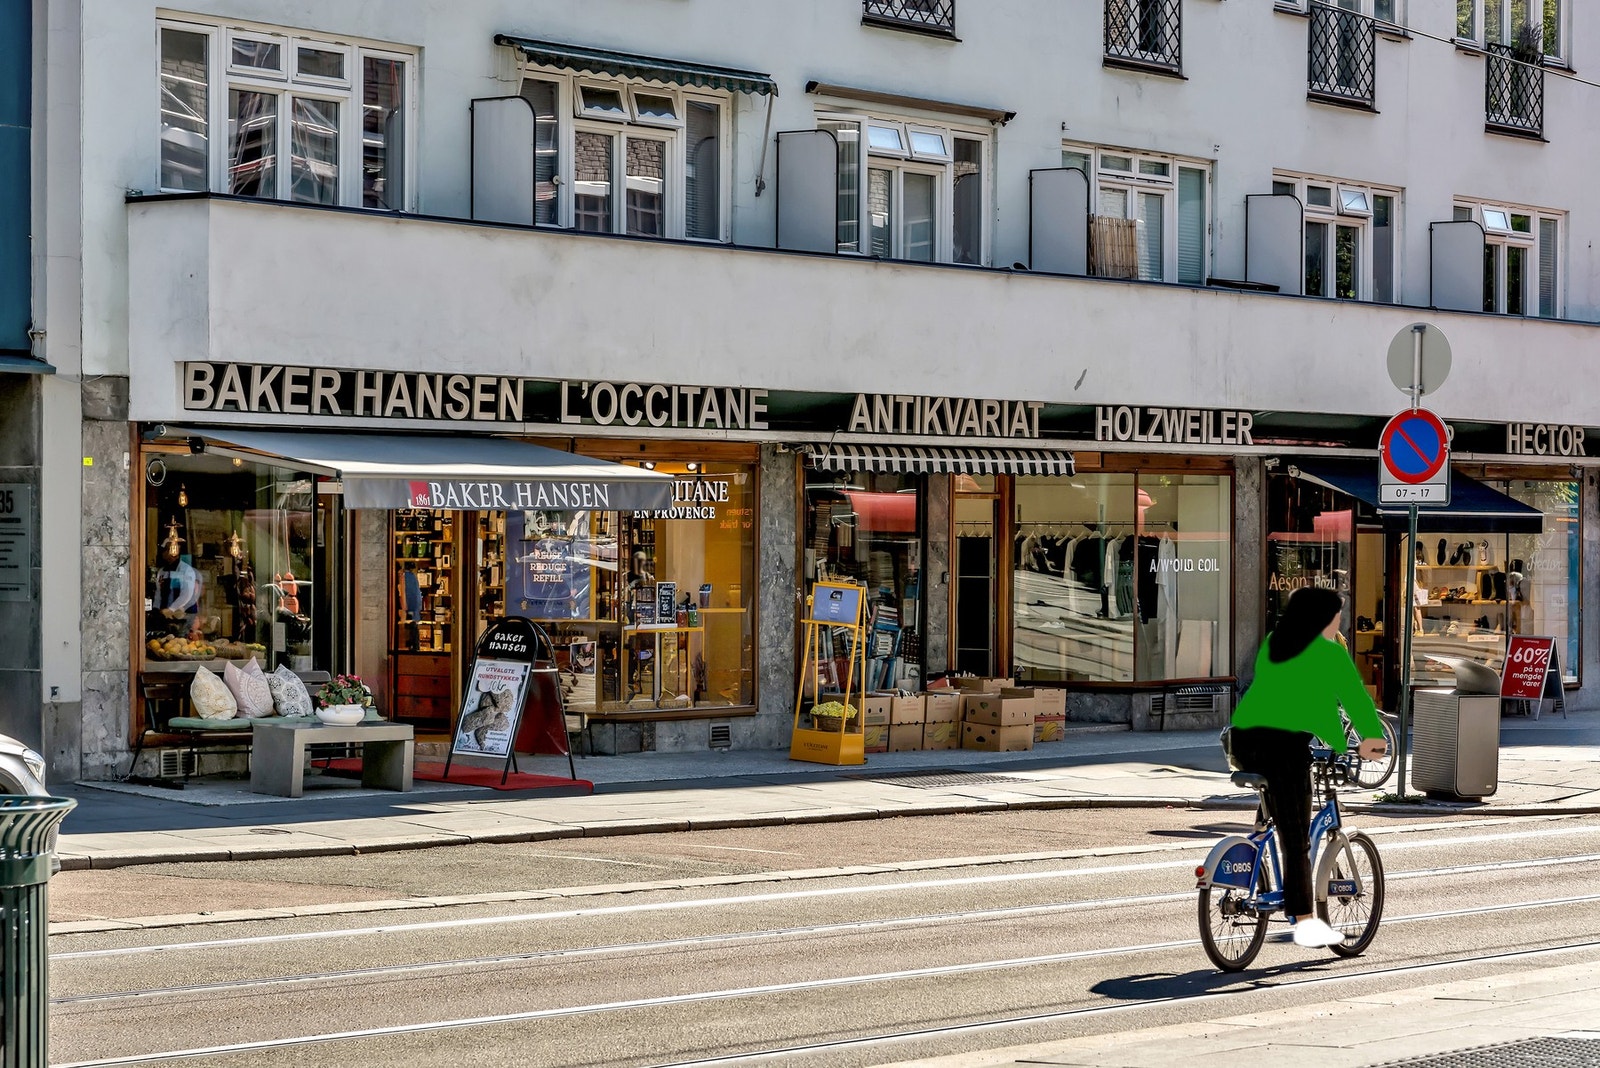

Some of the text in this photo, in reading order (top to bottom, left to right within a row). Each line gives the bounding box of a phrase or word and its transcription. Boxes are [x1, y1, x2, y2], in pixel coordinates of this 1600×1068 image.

[184, 362, 524, 421] BAKER HANSEN
[560, 380, 769, 430] L'OCCITANE
[848, 393, 1045, 438] ANTIKVARIAT
[1094, 406, 1254, 445] HOLZWEILER
[1506, 423, 1587, 456] HECTOR
[415, 481, 609, 509] 1861 BAKER HANSEN
[1395, 488, 1408, 498] 07
[1420, 488, 1430, 498] 17
[633, 506, 716, 519] EN PROVENCE
[534, 552, 563, 560] REUSE
[529, 562, 567, 571] REDUCE
[1198, 558, 1220, 572] COIL
[533, 574, 563, 582] REFILL
[485, 666, 516, 675] UTVALGTE
[1523, 665, 1533, 673] på
[477, 673, 520, 682] RUNDSTYKKER
[1512, 672, 1542, 681] mengde
[1232, 861, 1252, 873] OBOS
[1337, 884, 1353, 892] OBOS
